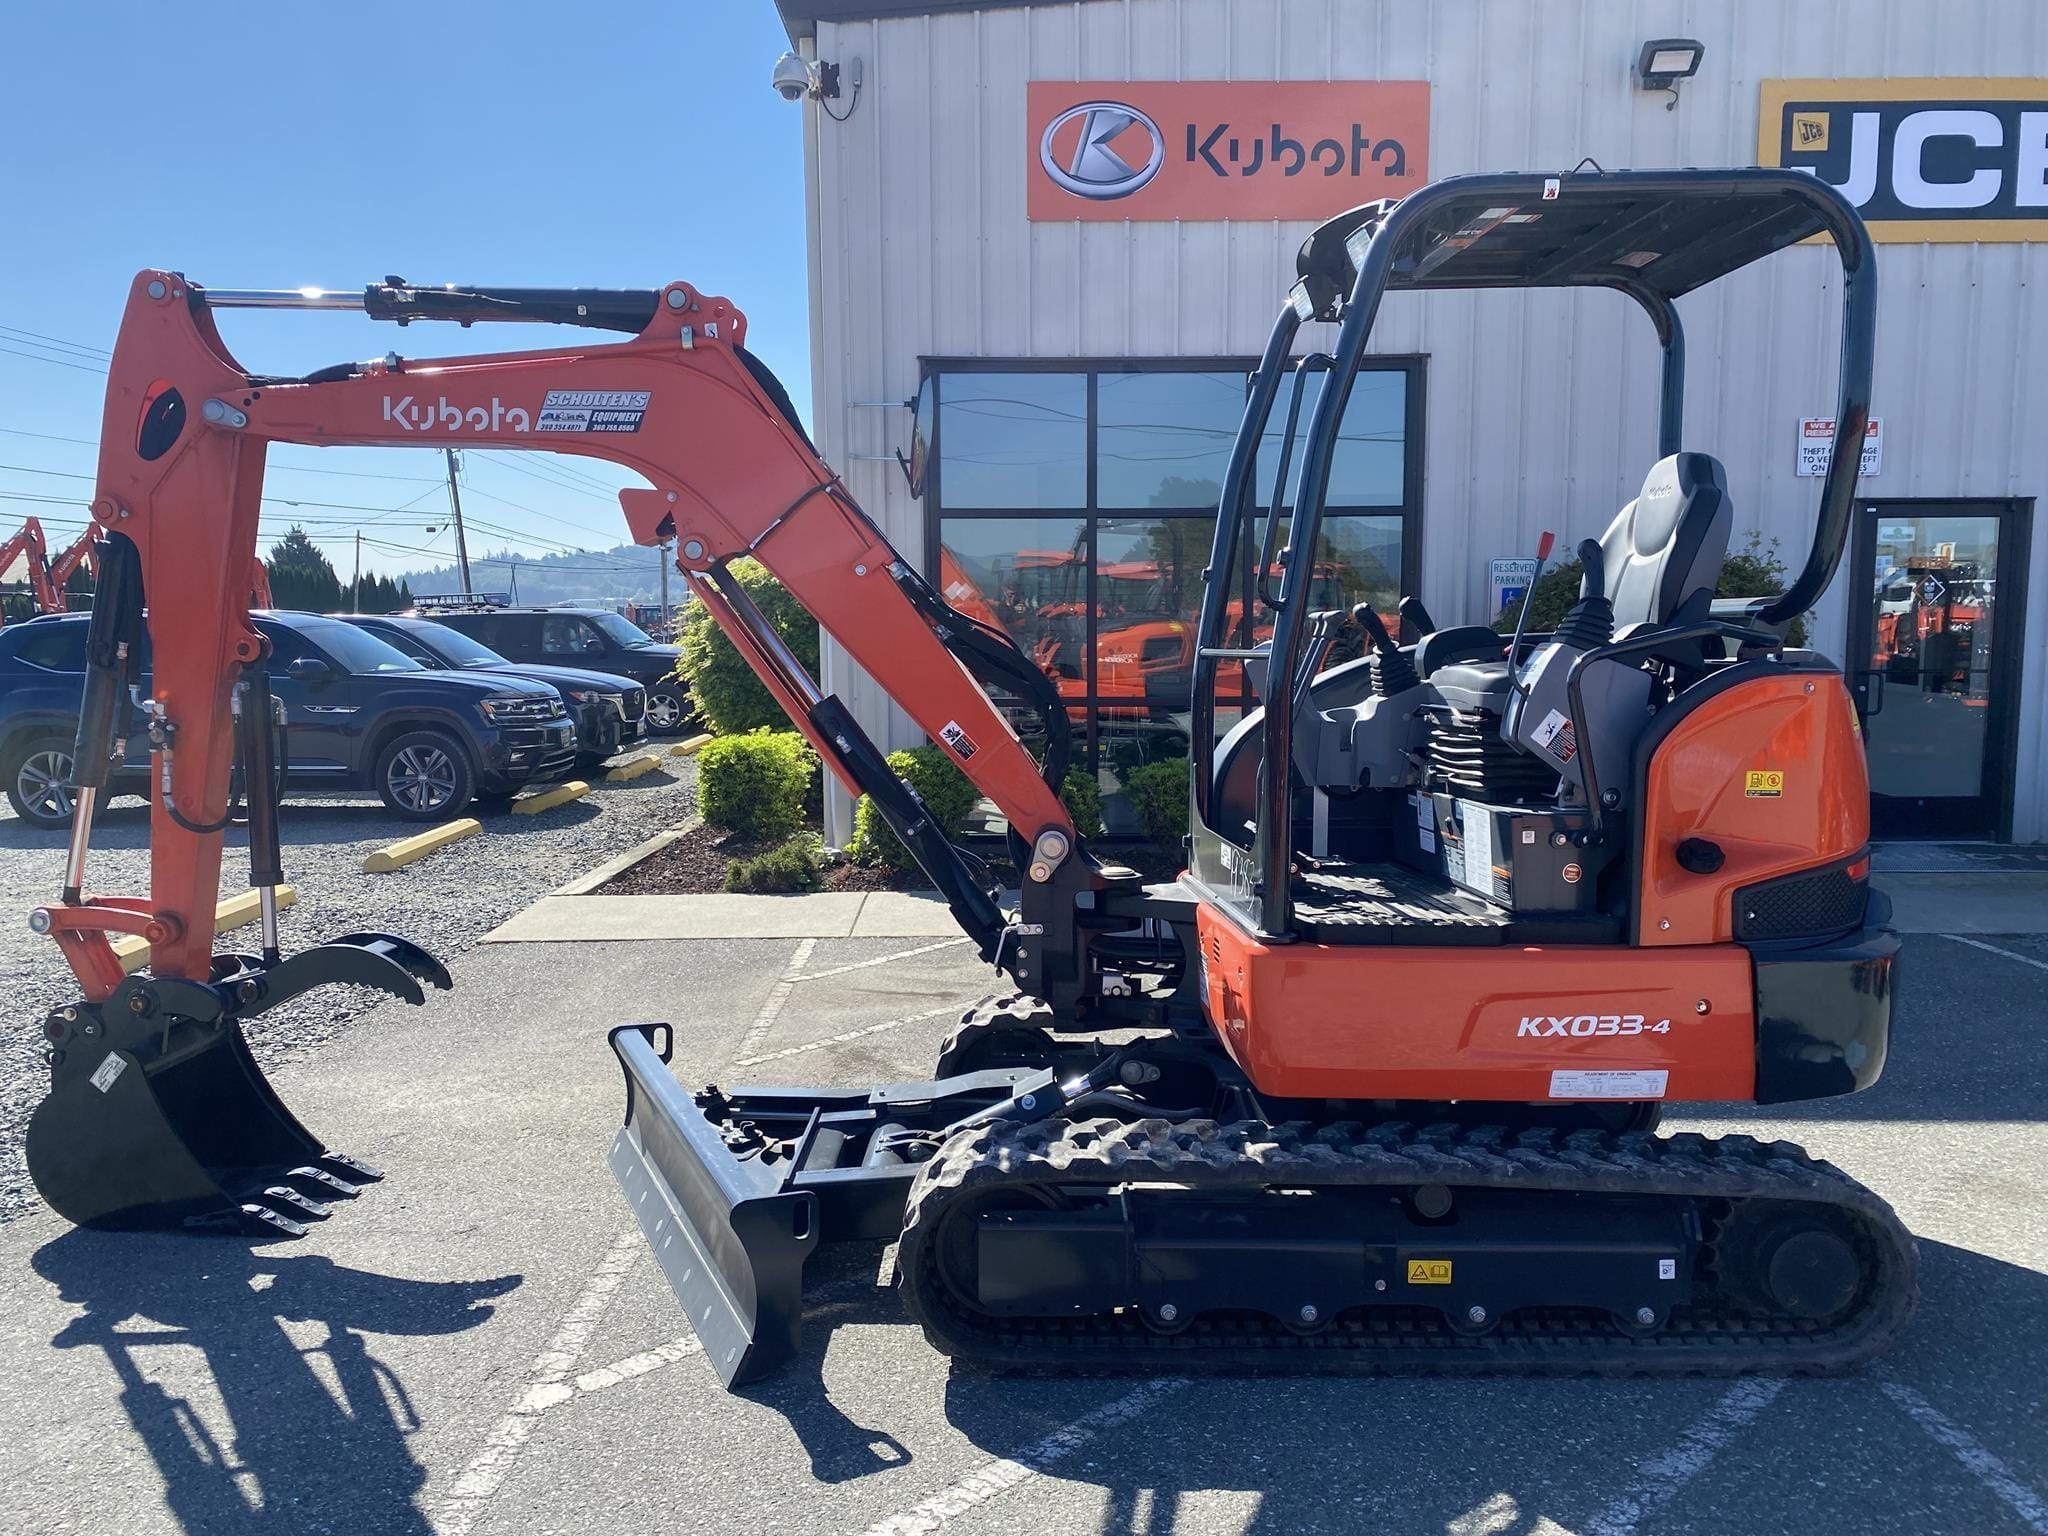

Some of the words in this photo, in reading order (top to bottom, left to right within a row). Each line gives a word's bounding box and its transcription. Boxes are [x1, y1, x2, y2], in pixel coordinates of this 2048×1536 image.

[1802, 123, 1823, 141] JCB
[1186, 124, 1406, 176] Kubota
[1790, 110, 2048, 208] JC
[546, 393, 647, 407] SCHOLTEN'S
[384, 396, 529, 432] Kubota
[592, 411, 642, 422] EQUIPMENT
[1803, 447, 1826, 455] THEFT
[1811, 464, 1825, 472] ON
[1494, 563, 1535, 573] RESERVED
[1495, 576, 1531, 585] PARKING
[1517, 1015, 1671, 1037] KX033-4
